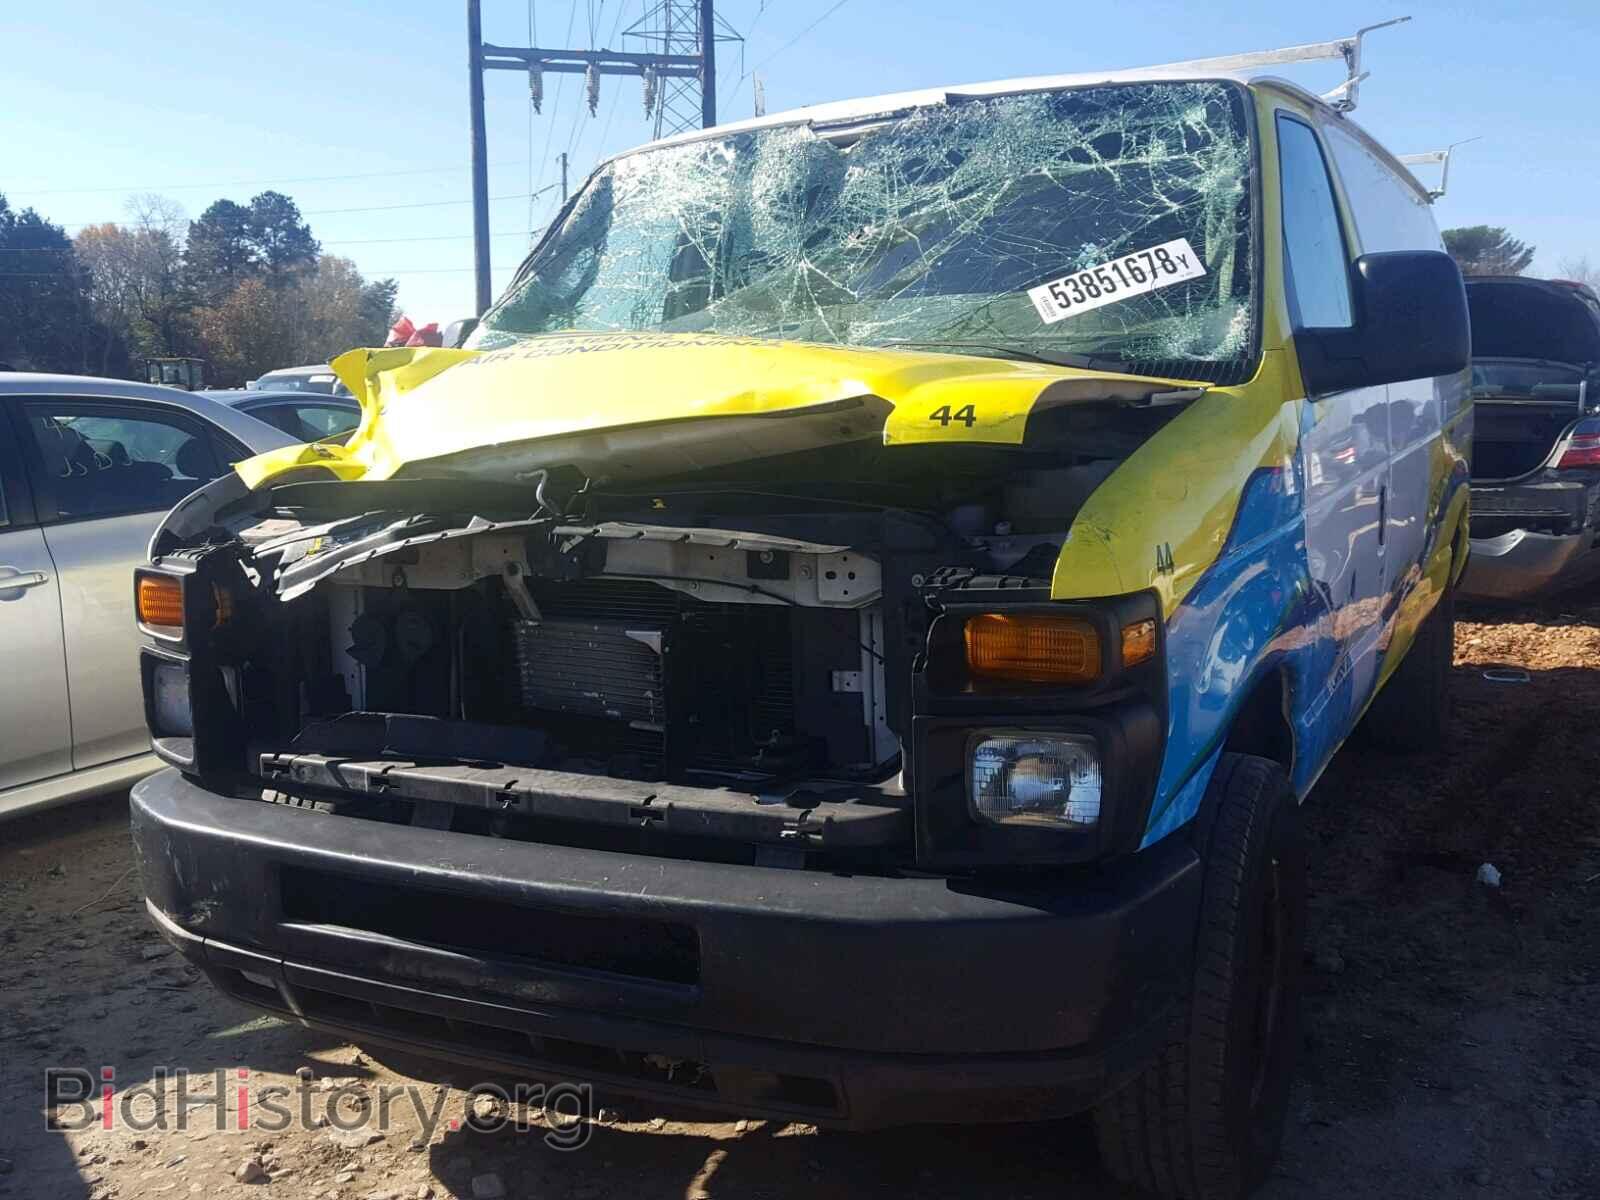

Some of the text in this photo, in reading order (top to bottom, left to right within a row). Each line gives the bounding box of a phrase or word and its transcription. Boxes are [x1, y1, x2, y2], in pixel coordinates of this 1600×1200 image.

[1048, 247, 1178, 309] 53851678
[1176, 253, 1190, 270] Y
[459, 351, 515, 368] AIR
[929, 404, 976, 428] 44
[1156, 542, 1174, 577] 44
